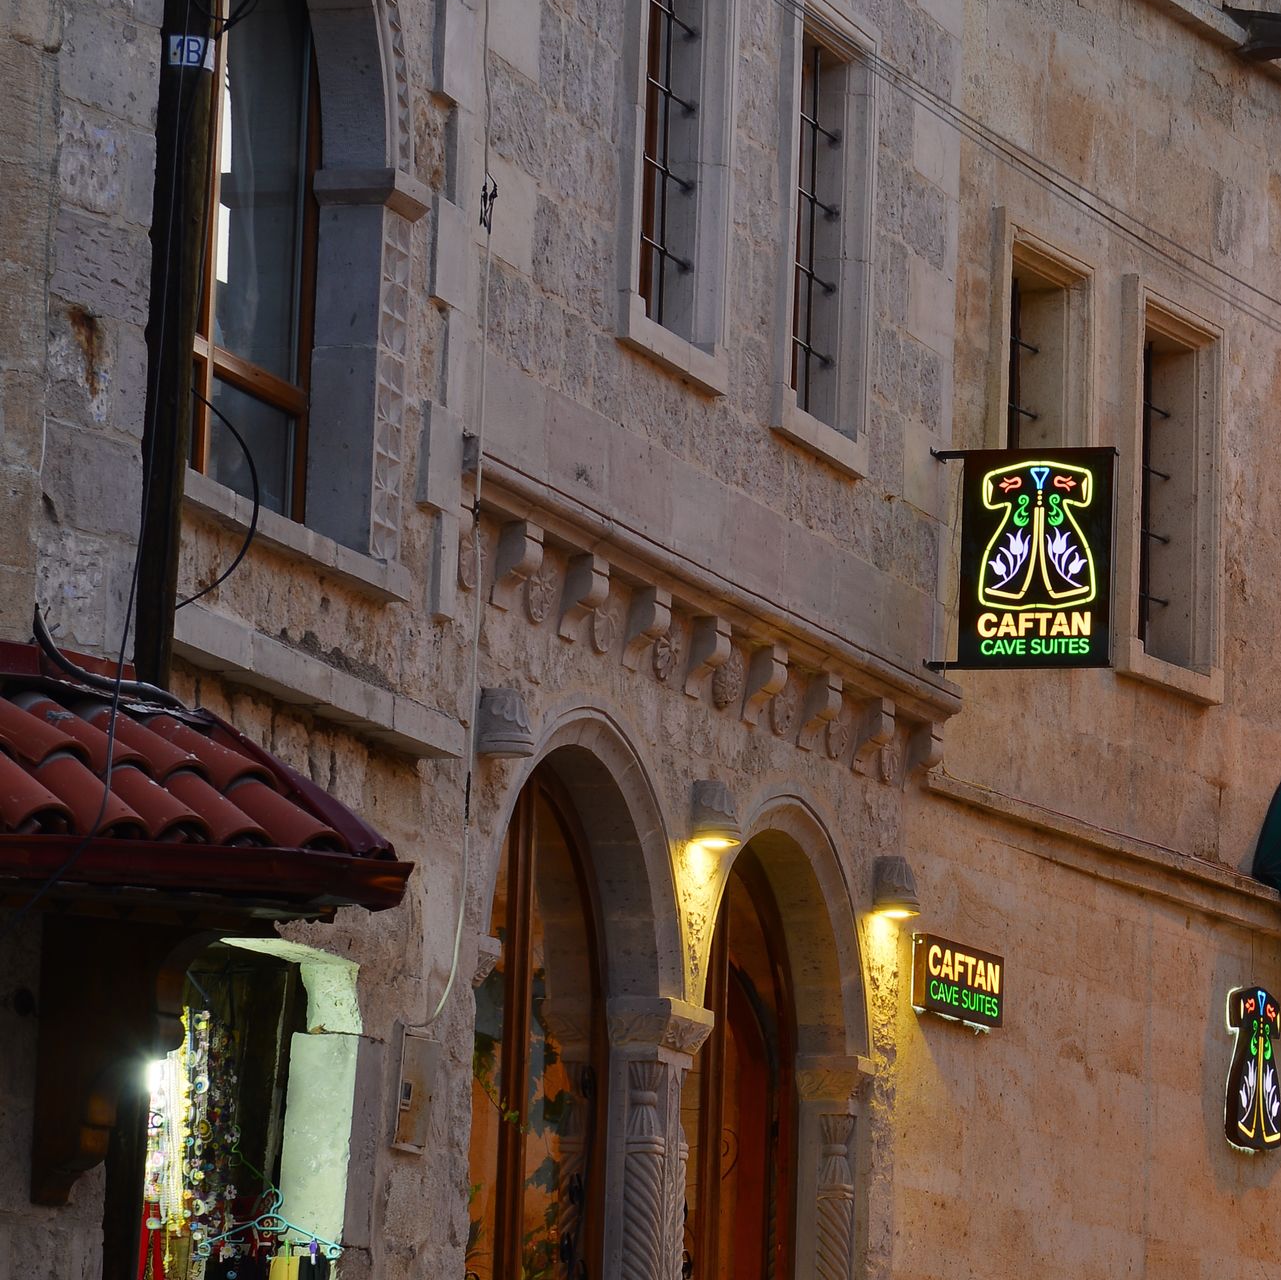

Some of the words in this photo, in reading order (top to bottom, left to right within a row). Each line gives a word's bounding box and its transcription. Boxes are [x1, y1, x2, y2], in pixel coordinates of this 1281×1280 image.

[176, 38, 201, 65] 1B
[977, 612, 1091, 637] CAFTAN
[980, 639, 1026, 655] CAVE
[1030, 638, 1090, 654] SUITES
[928, 944, 1000, 994] CAFTAN
[930, 980, 959, 1005] CAVE
[961, 989, 998, 1017] SUITES
